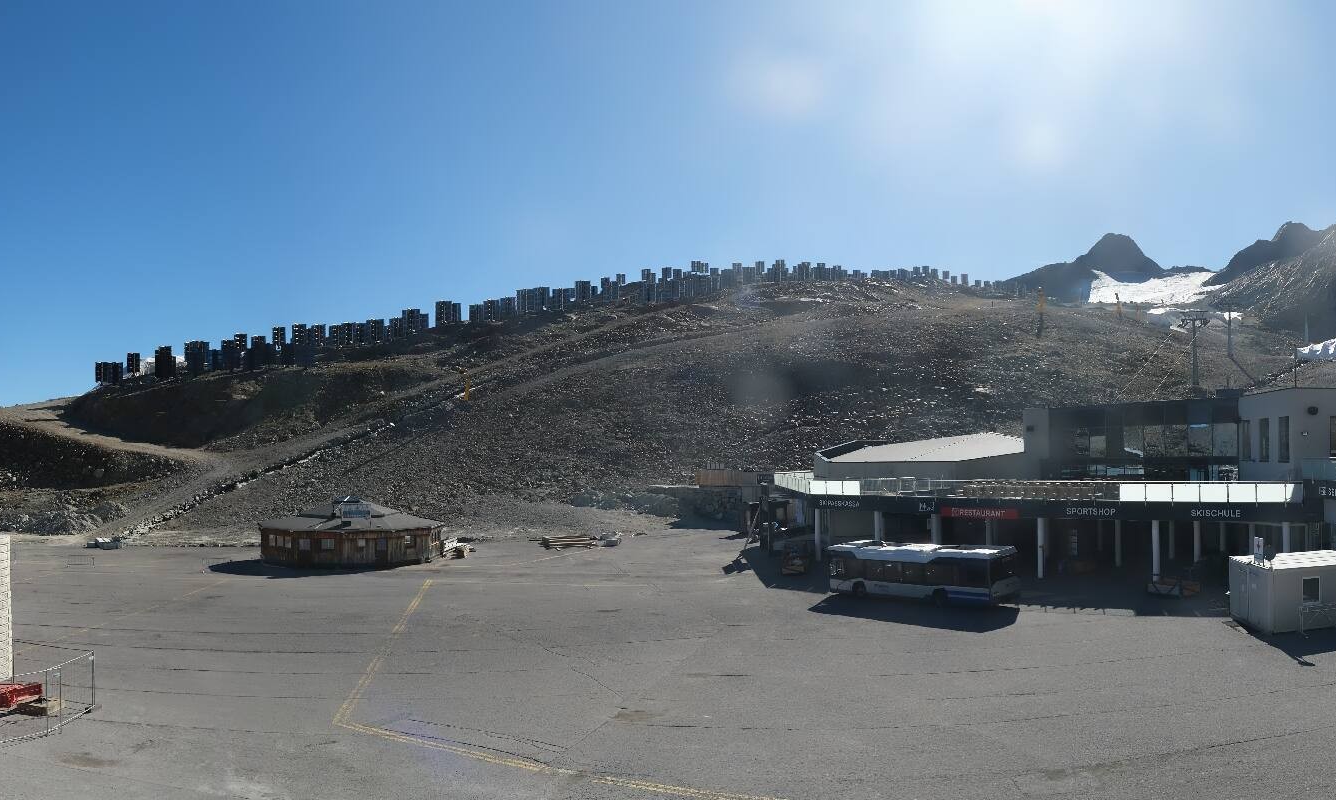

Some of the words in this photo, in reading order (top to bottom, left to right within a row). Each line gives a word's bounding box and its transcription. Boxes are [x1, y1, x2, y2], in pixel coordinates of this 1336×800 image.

[959, 509, 1006, 518] RESTAURANT
[1066, 507, 1116, 516] SPORTSHOP
[1190, 509, 1241, 518] SKISCHULE
